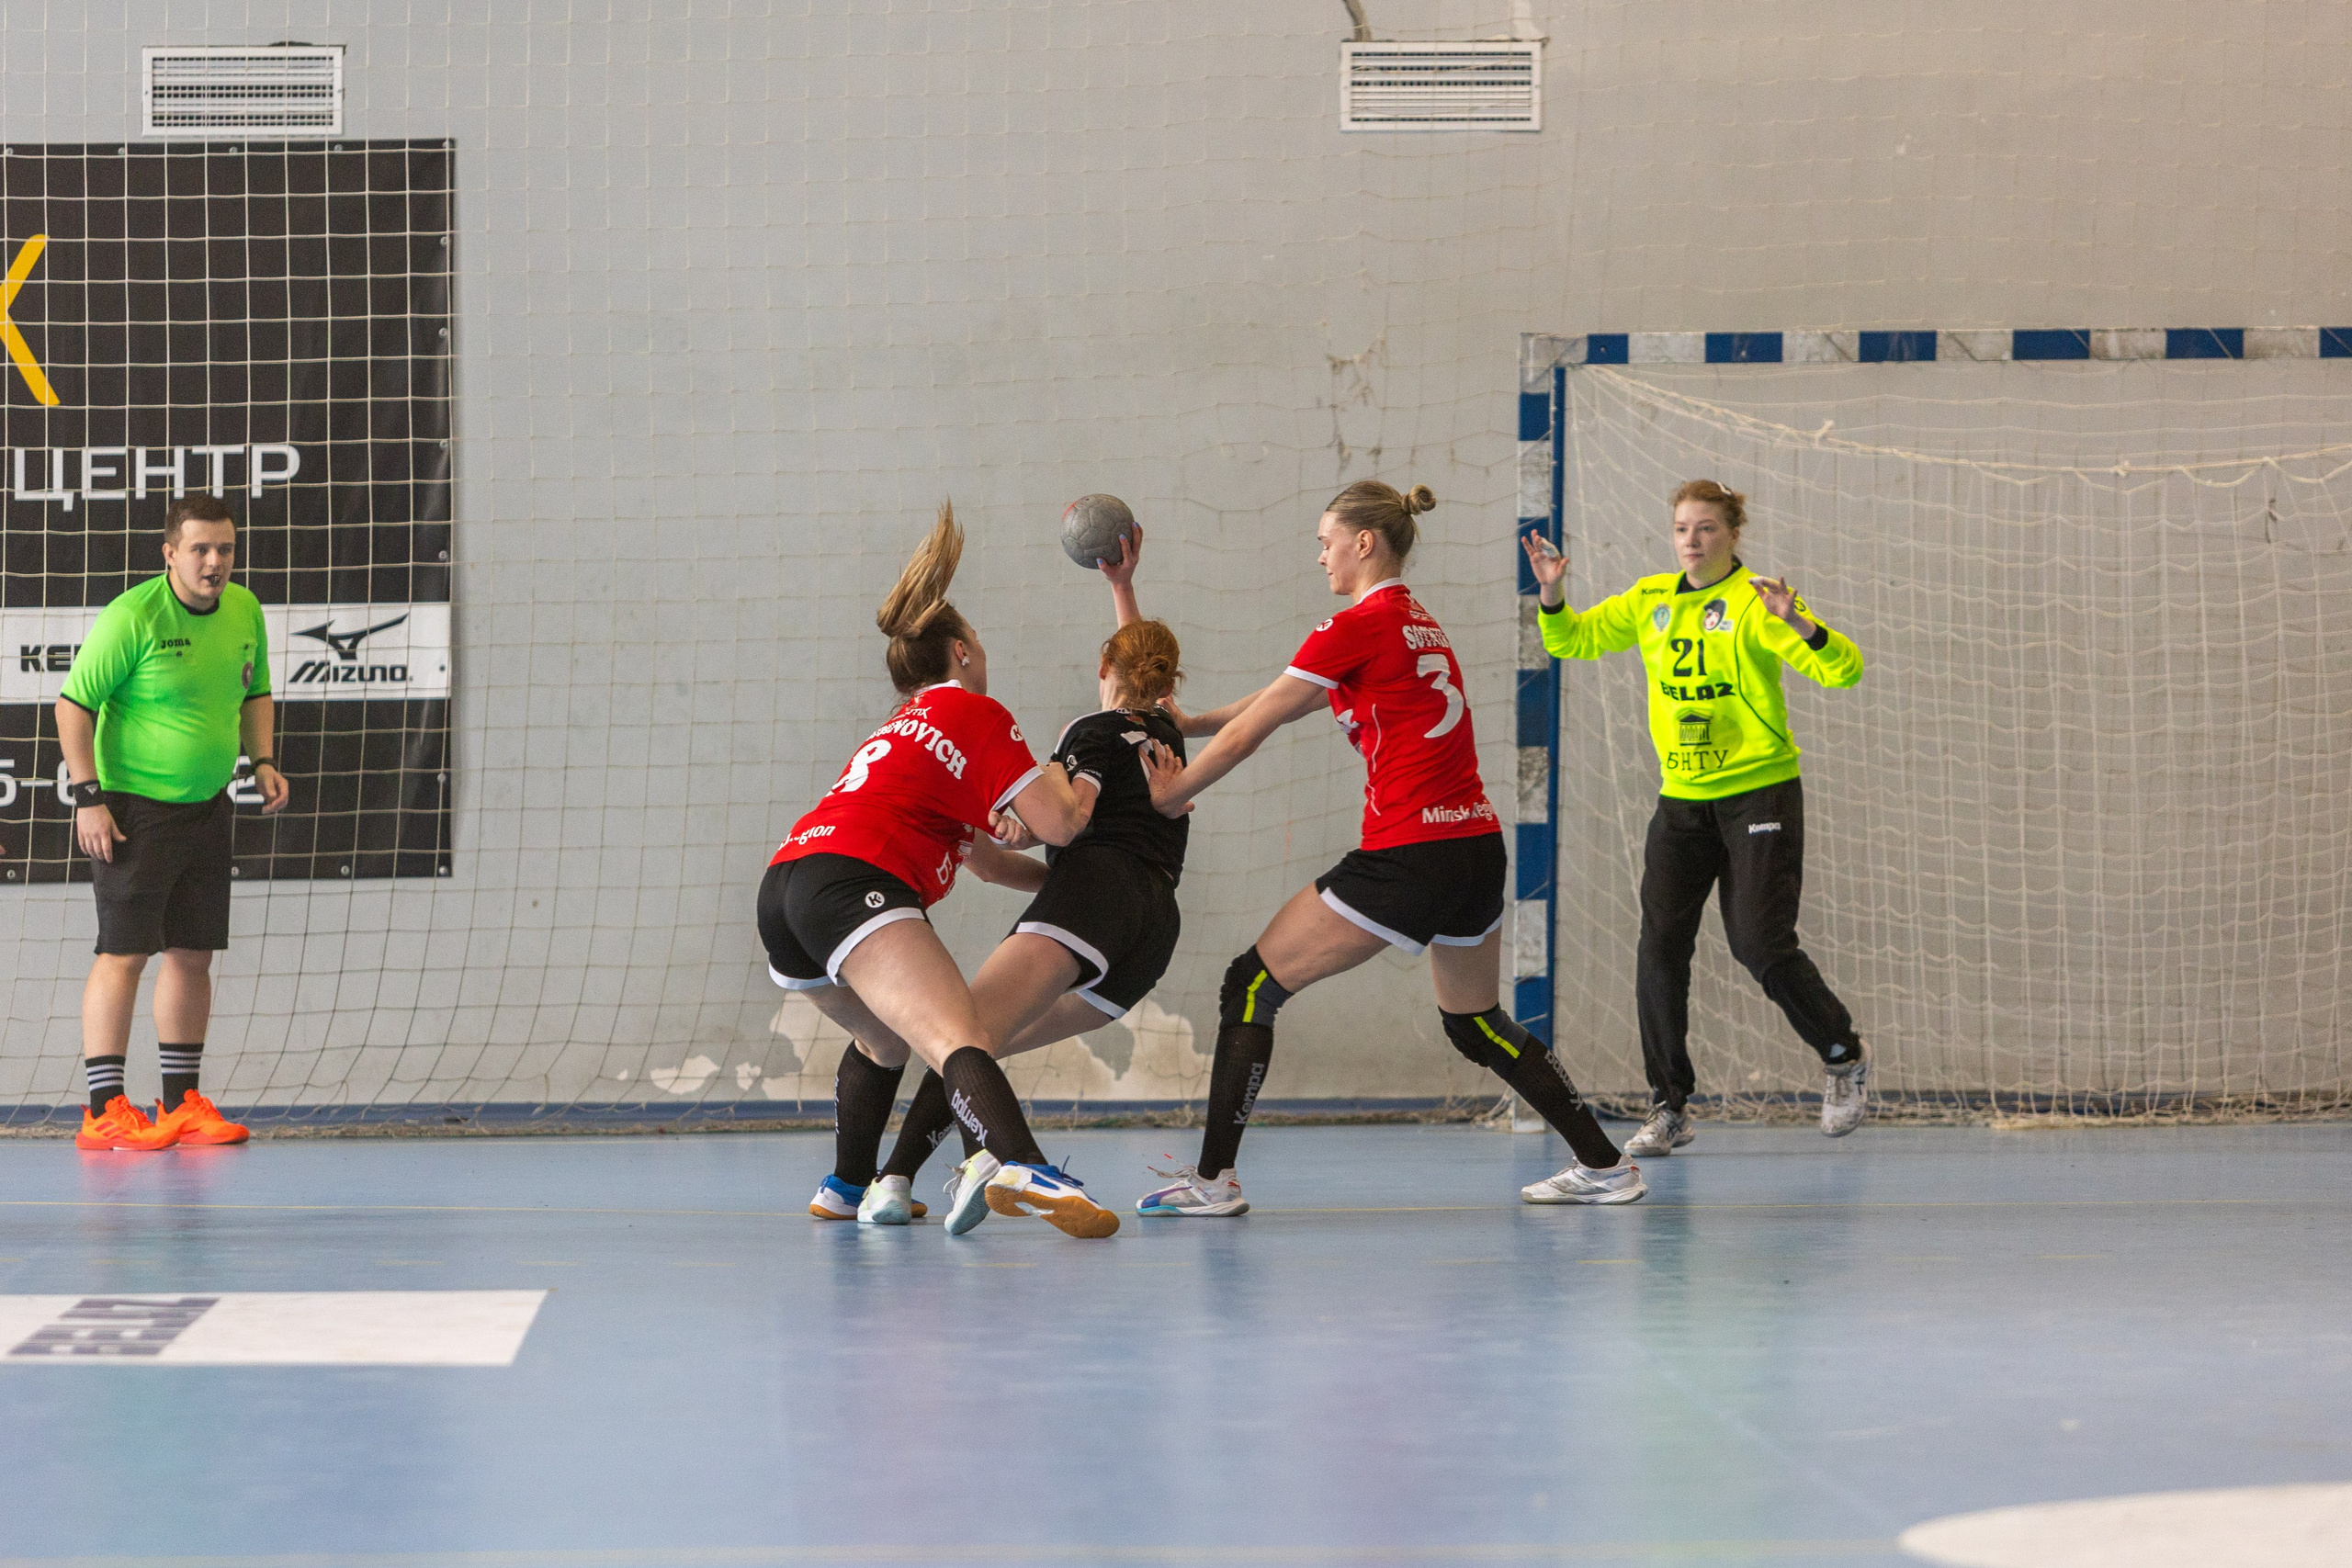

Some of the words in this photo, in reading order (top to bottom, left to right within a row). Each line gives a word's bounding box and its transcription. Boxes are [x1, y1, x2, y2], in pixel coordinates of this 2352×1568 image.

[14, 444, 300, 512] ЦЕНТР
[20, 645, 83, 672] KE
[1670, 637, 1708, 677] 21
[1416, 653, 1464, 739] 3
[1659, 681, 1736, 701] BELAZ
[1666, 750, 1729, 771] БНТУ
[1421, 805, 1471, 824] Minsk
[1232, 1062, 1266, 1124] Kempa
[950, 1088, 989, 1147] Kempa
